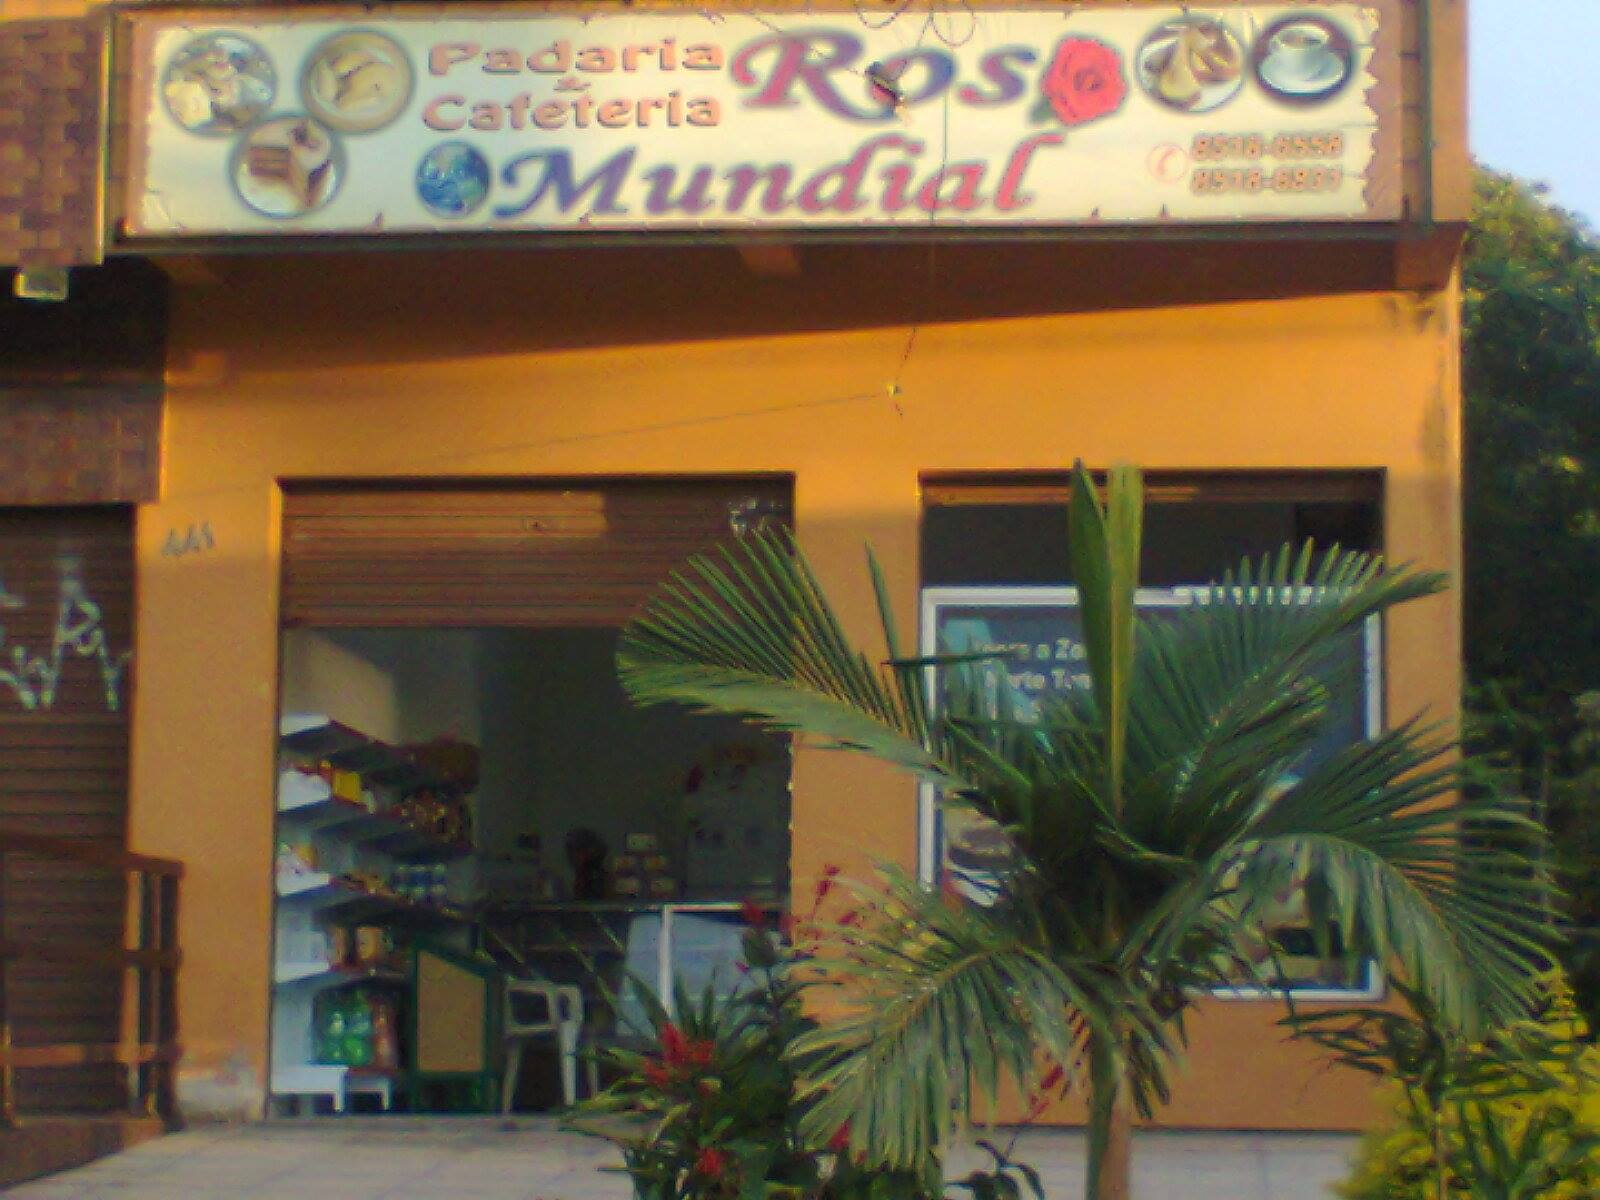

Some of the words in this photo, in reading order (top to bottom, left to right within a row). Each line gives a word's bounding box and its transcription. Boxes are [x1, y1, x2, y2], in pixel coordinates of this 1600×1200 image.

[428, 38, 724, 76] Padaria
[422, 91, 722, 131] Cafeteria
[493, 132, 1066, 217] Mundial
